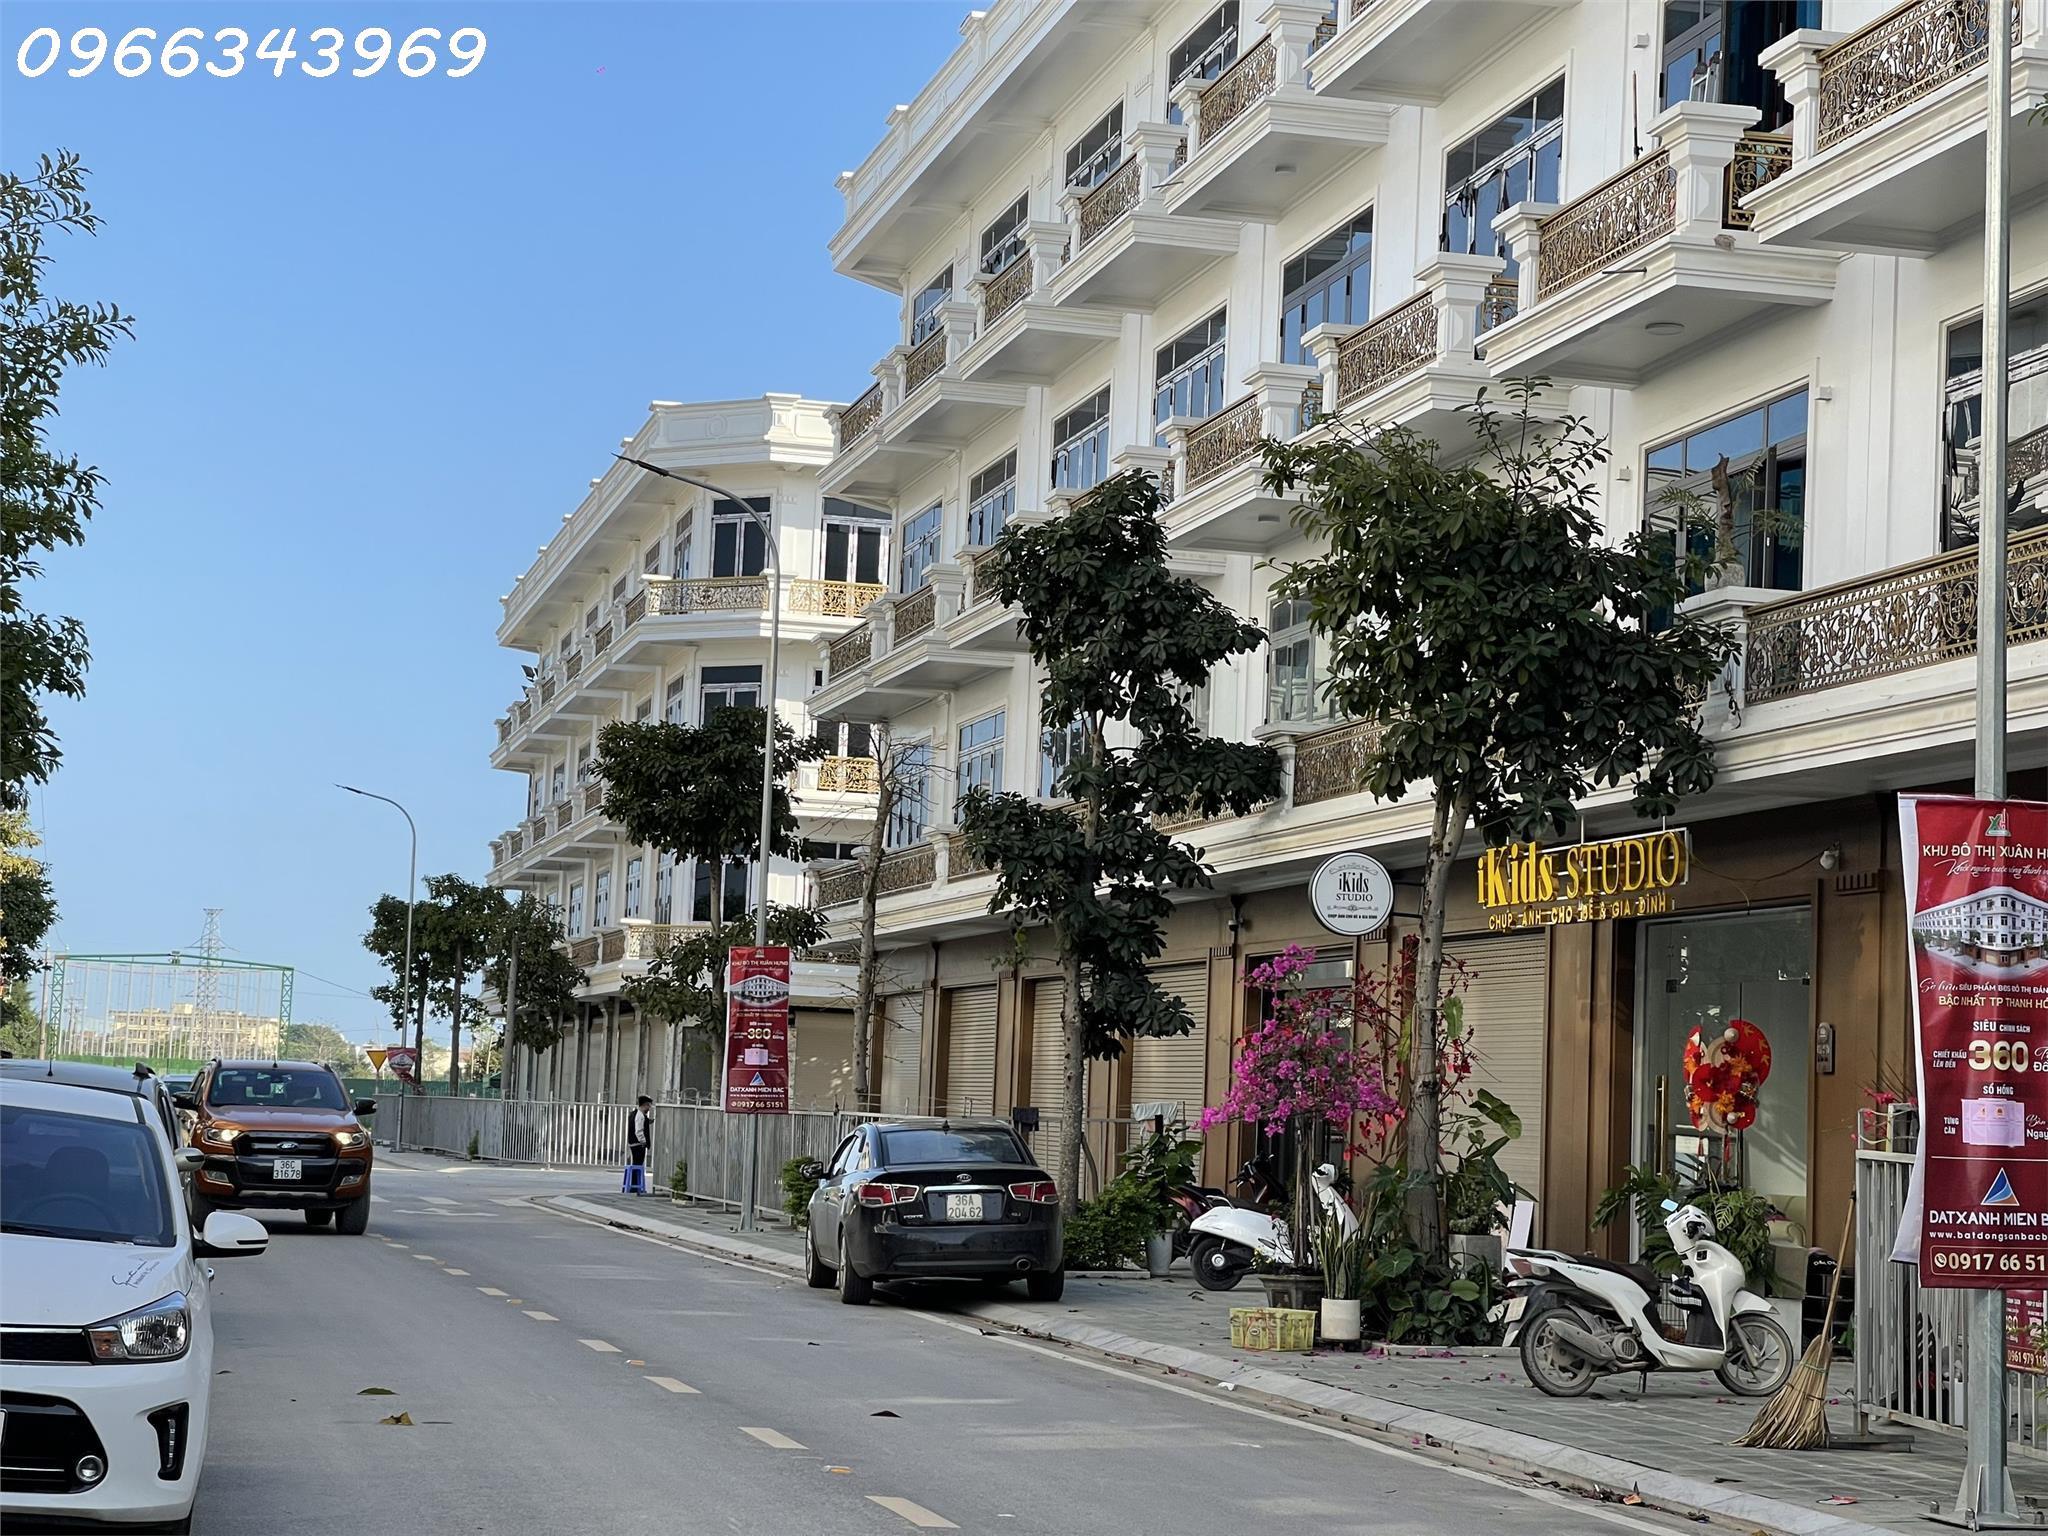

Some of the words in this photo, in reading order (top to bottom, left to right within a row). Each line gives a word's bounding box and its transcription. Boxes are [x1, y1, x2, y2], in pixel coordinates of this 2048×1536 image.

[1923, 845, 1948, 856] KHU
[1951, 842, 1971, 856] ĐÔ
[1975, 845, 1995, 860] THỊ
[2000, 843, 2033, 859] XUÂN
[2037, 848, 2048, 859] H
[1477, 841, 1556, 908] iKids
[1566, 832, 1681, 899] STUDIO
[1338, 872, 1369, 893] iKids
[1336, 893, 1373, 902] STUDIO
[1489, 913, 1513, 933] CHỤP
[1551, 905, 1573, 924] CHO
[1600, 901, 1606, 920] &
[1611, 899, 1631, 918] GIA
[1939, 994, 1959, 1007] BẬC
[1961, 993, 1986, 1006] NHẤT
[1989, 997, 2004, 1006] TP
[2005, 998, 2033, 1008] THANH
[1973, 1019, 1996, 1032] SIÊU
[1969, 1040, 2029, 1073] 360
[280, 1160, 295, 1169] 36C
[955, 1195, 974, 1206] 36A
[1929, 1210, 2000, 1225] DATXANH
[2003, 1212, 2037, 1226] MIEN
[1948, 1252, 1995, 1270] 0917
[1999, 1254, 2021, 1271] 66
[2025, 1255, 2046, 1271] 51
[2022, 1352, 2035, 1365] 979
